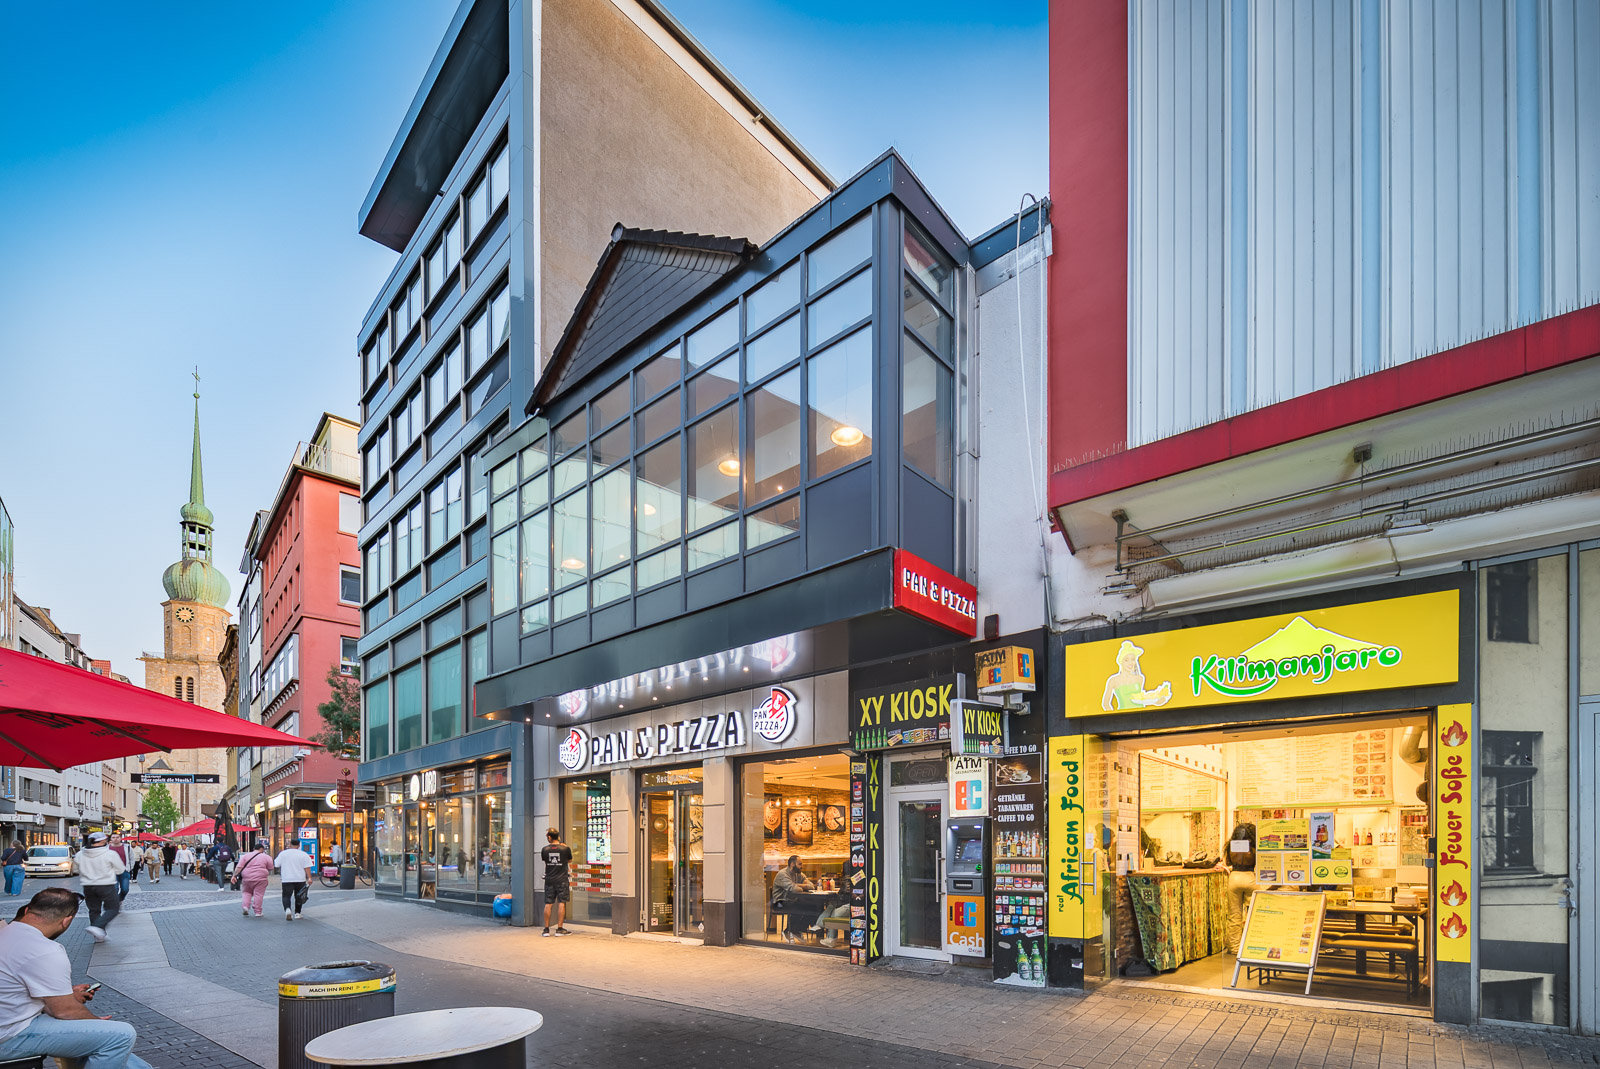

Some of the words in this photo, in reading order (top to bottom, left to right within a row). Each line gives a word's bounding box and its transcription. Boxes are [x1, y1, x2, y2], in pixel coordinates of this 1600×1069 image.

[902, 568, 928, 597] PAN
[941, 586, 976, 620] PIZZA
[982, 650, 1006, 662] ATM
[1190, 645, 1402, 696] Kilimanjaro
[754, 710, 768, 720] PAN
[860, 696, 884, 727] XY
[890, 684, 953, 722] KIOSK
[964, 708, 975, 734] XY
[978, 710, 1002, 736] KIOSK
[592, 730, 633, 765] PAN
[658, 710, 746, 756] PIZZA
[754, 721, 779, 731] PIZZA
[955, 757, 982, 770] ATM
[1441, 755, 1467, 804] Soße
[870, 758, 879, 812] XY
[998, 794, 1026, 802] GETRÄNKE
[1061, 761, 1084, 813] Food
[998, 804, 1034, 812] TABAKWAREN
[1026, 814, 1034, 822] GO
[1440, 811, 1468, 870] Feuer
[1061, 820, 1084, 904] African
[869, 823, 879, 958] KIOSK
[1055, 895, 1064, 912] real
[950, 931, 985, 948] Cash
